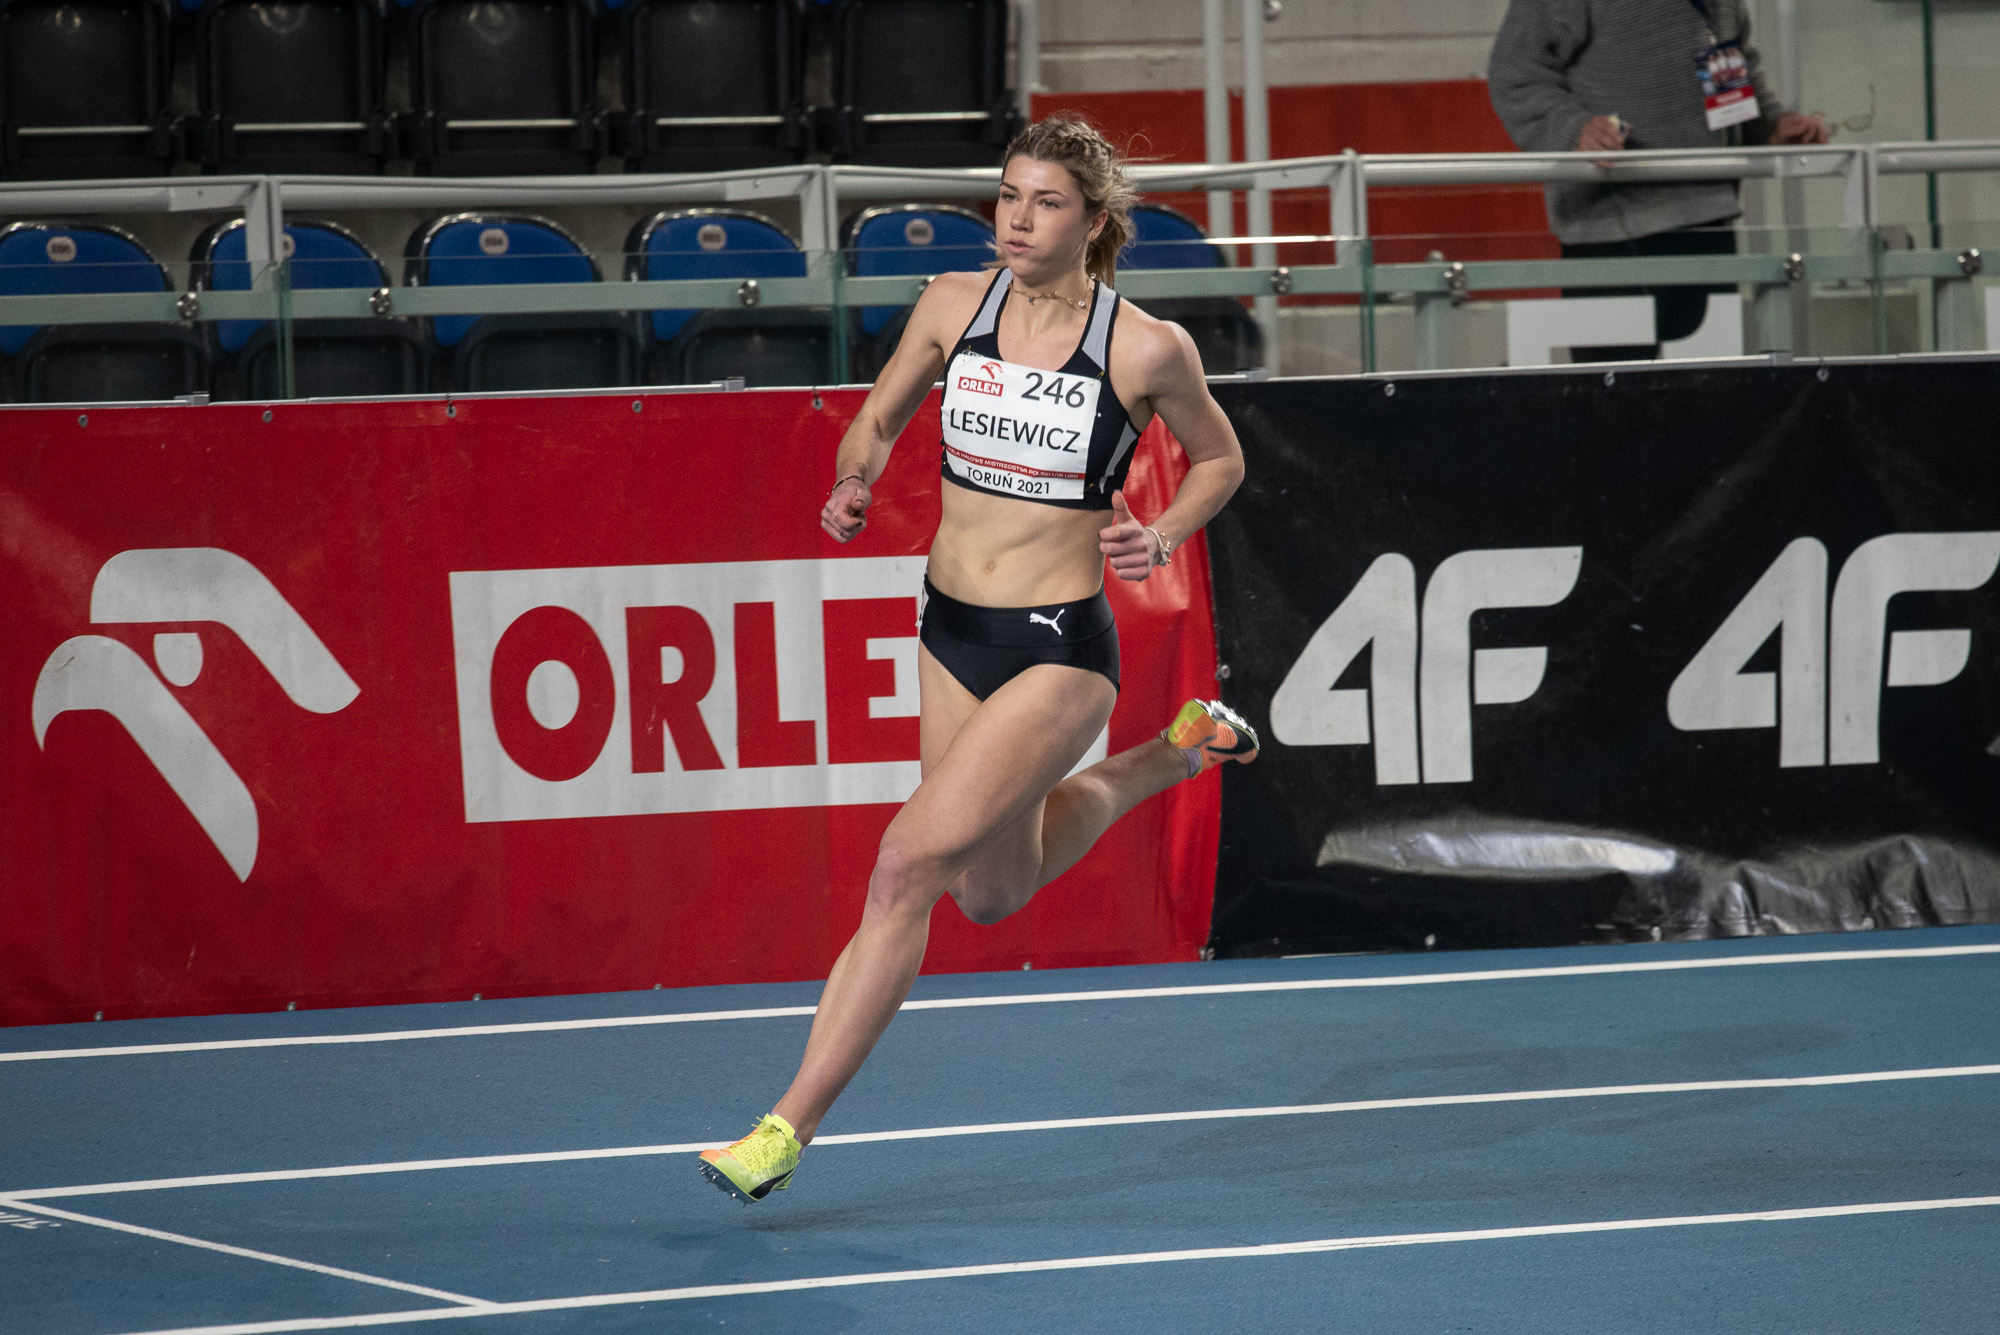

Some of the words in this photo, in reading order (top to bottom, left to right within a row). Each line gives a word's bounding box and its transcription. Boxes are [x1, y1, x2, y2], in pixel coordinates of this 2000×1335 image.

[959, 378, 1002, 396] ORLEN
[1021, 372, 1085, 409] 246
[950, 408, 1081, 454] LESIEWICZ
[961, 451, 983, 464] HALOWE
[984, 459, 1028, 474] MISTRZOSTWA
[966, 466, 1013, 489] TORUŃ
[1017, 479, 1050, 494] 2021
[1270, 546, 1583, 786] 4F
[1667, 531, 2000, 768] 4F
[490, 597, 921, 783] ORLE
